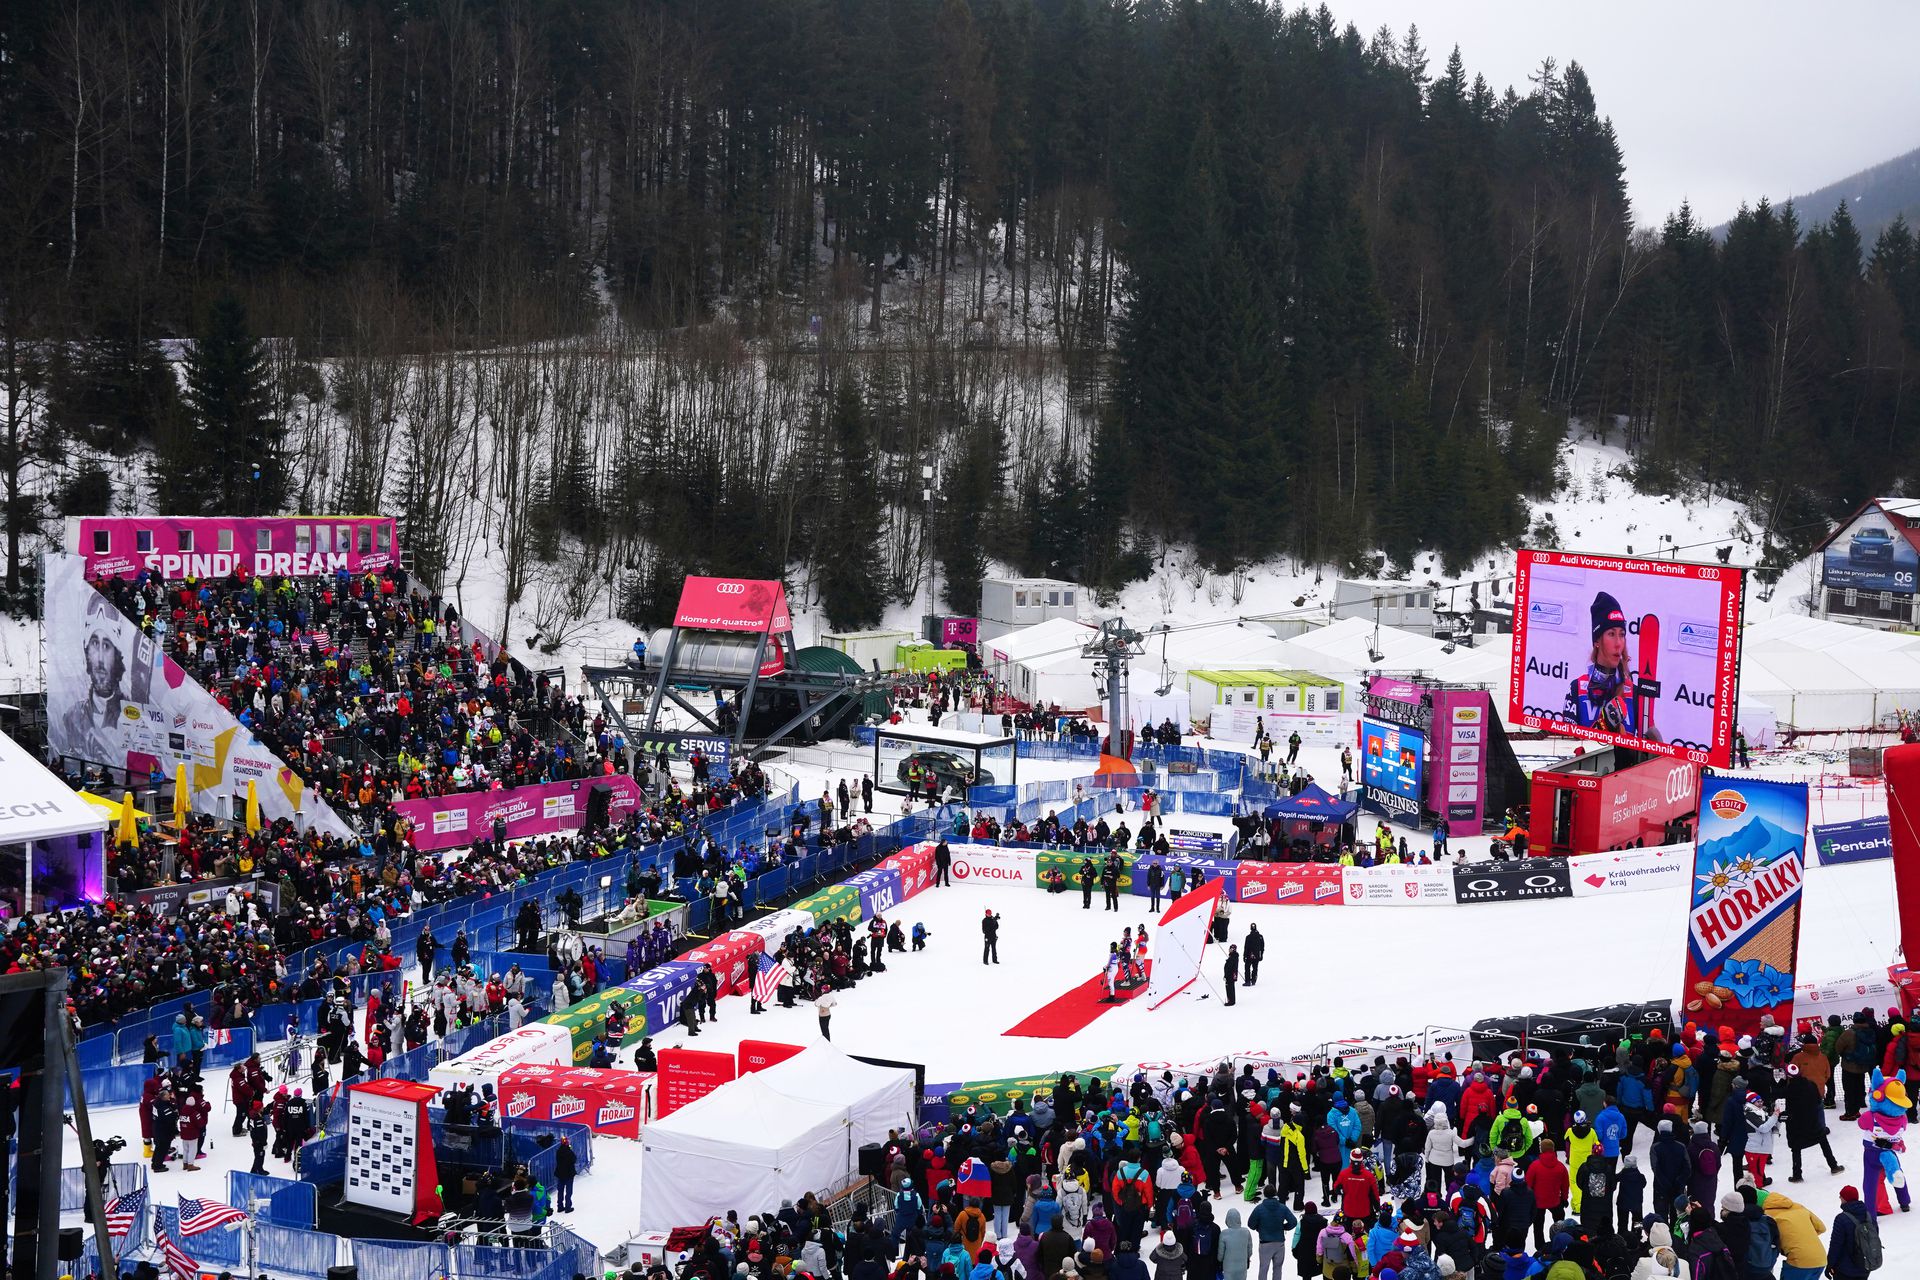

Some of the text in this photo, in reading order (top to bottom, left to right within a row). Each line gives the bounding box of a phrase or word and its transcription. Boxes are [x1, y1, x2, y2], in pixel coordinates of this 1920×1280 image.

[255, 552, 348, 576] DREAM
[1560, 555, 1686, 574] Audi Vorsprung durch Technik
[1894, 571, 1912, 584] Q6
[1516, 595, 1524, 632] World
[959, 622, 972, 634] 5G
[1526, 656, 1568, 680] Audi
[1718, 590, 1735, 746] Audi FIS Ski World Cup
[149, 710, 164, 723] VISA
[1551, 722, 1675, 755] Audi Vorsprung durch Technik
[681, 739, 725, 753] SERVIS
[234, 757, 272, 770] BOHUMÍR ZEMAN
[233, 766, 262, 777] GRANDSTAND
[1366, 785, 1419, 815] LONGINES
[1614, 791, 1628, 805] Audi
[1716, 799, 1742, 810] SEDITA
[1613, 798, 1658, 824] FIS Ski World Cup
[1179, 830, 1213, 838] LONGINES
[973, 867, 1022, 880] VEOLIA
[1608, 864, 1680, 878] Královéhradecký
[1610, 878, 1627, 887] kraj
[155, 892, 178, 900] MTECH
[1244, 886, 1266, 896] HORALKY
[1280, 886, 1302, 896] HORALKY
[1317, 886, 1339, 896] HORALKY
[1461, 890, 1507, 898] OAKLEY
[1518, 886, 1566, 895] OAKLEY
[869, 886, 894, 915] VISA
[1696, 858, 1800, 949] HORALKY
[150, 902, 169, 914] VIP
[664, 982, 672, 991] VISA
[647, 990, 656, 1000] VISA
[1434, 1034, 1465, 1044] MONVIA
[1386, 1041, 1416, 1050] MONVIA
[1338, 1048, 1368, 1056] MONVIA
[923, 1096, 943, 1104] VISA
[510, 1099, 535, 1115] HORALKY
[554, 1101, 584, 1116] HORALKY
[601, 1109, 633, 1121] HORALKY
